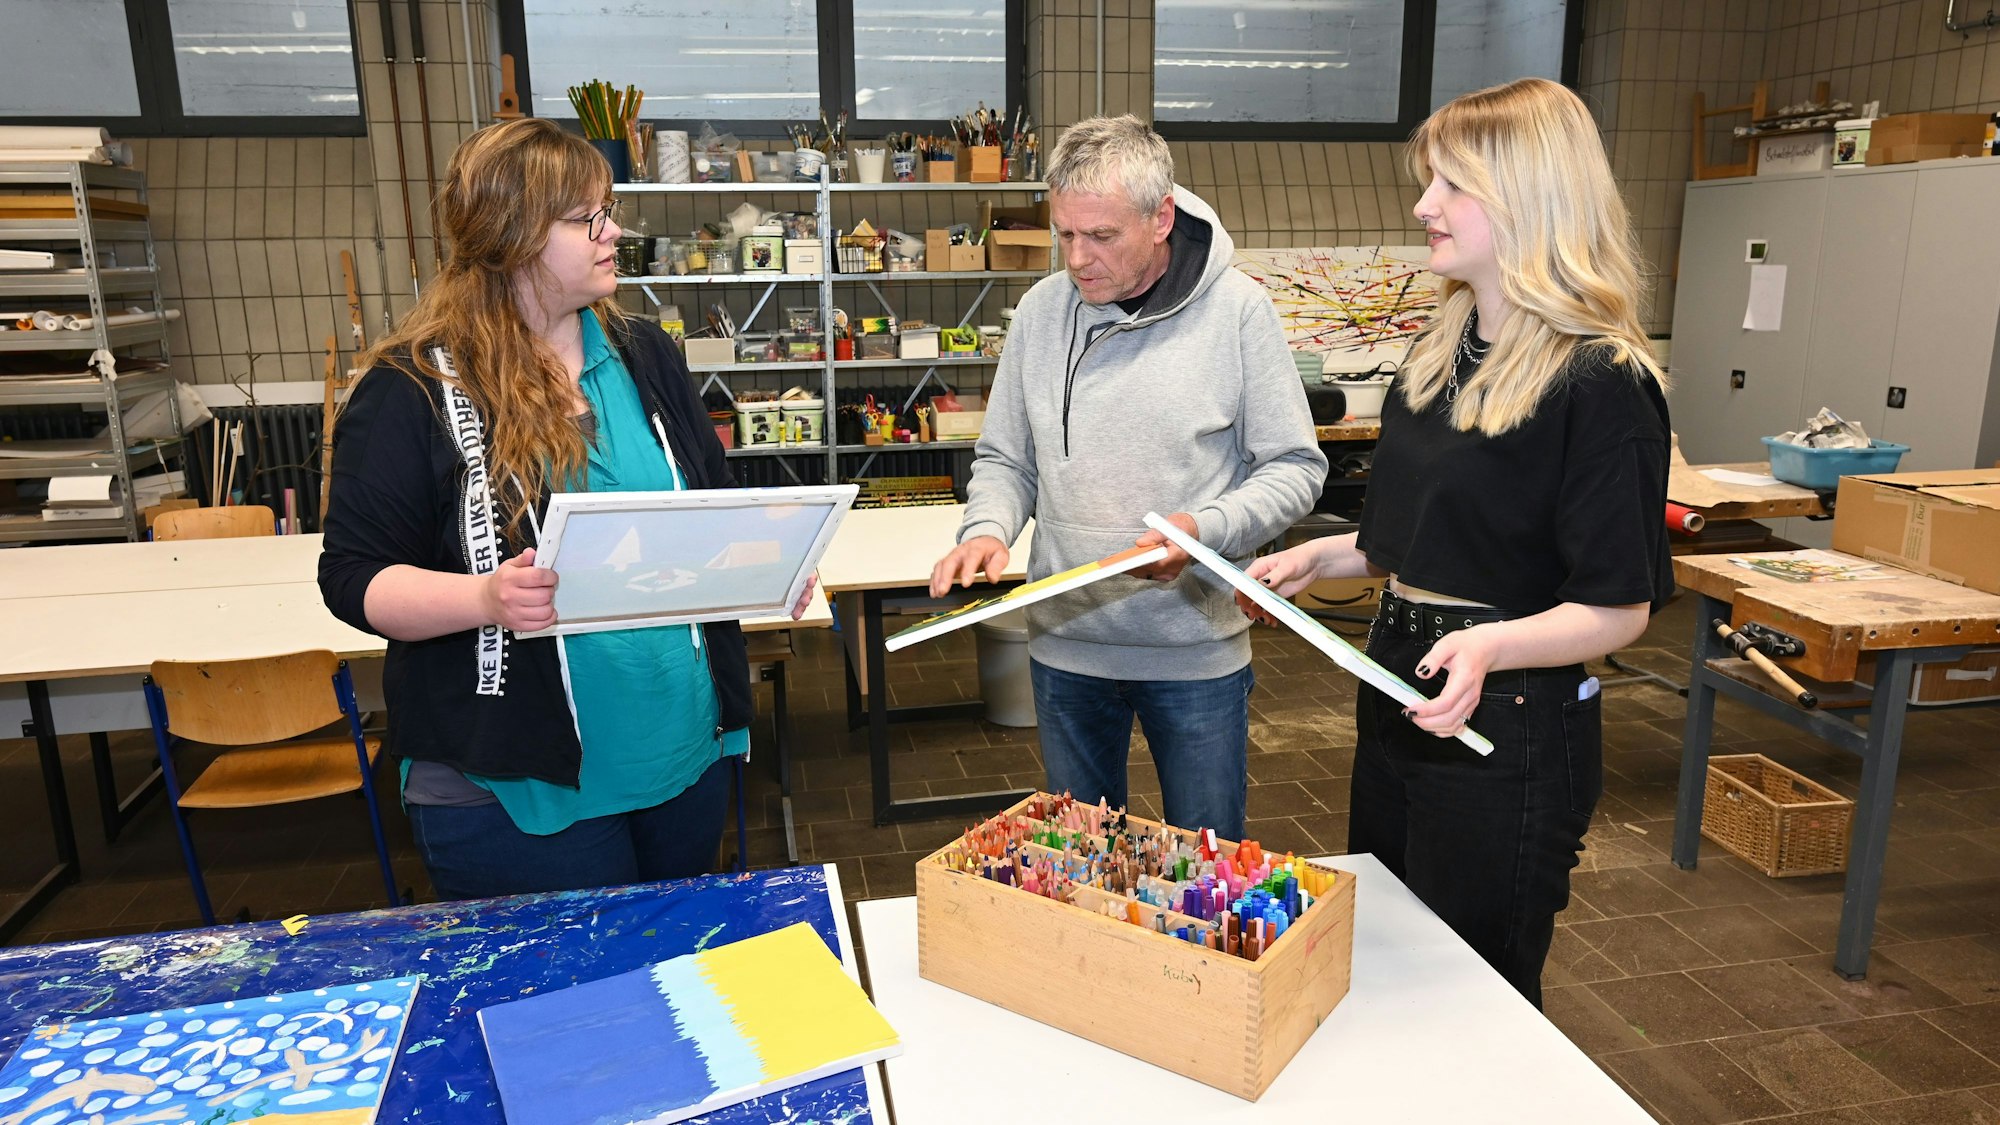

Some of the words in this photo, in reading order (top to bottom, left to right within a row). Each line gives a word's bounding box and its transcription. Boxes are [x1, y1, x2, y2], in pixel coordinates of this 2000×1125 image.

[452, 386, 480, 451] OTHER
[475, 545, 494, 574] ER
[481, 659, 497, 692] IKE
